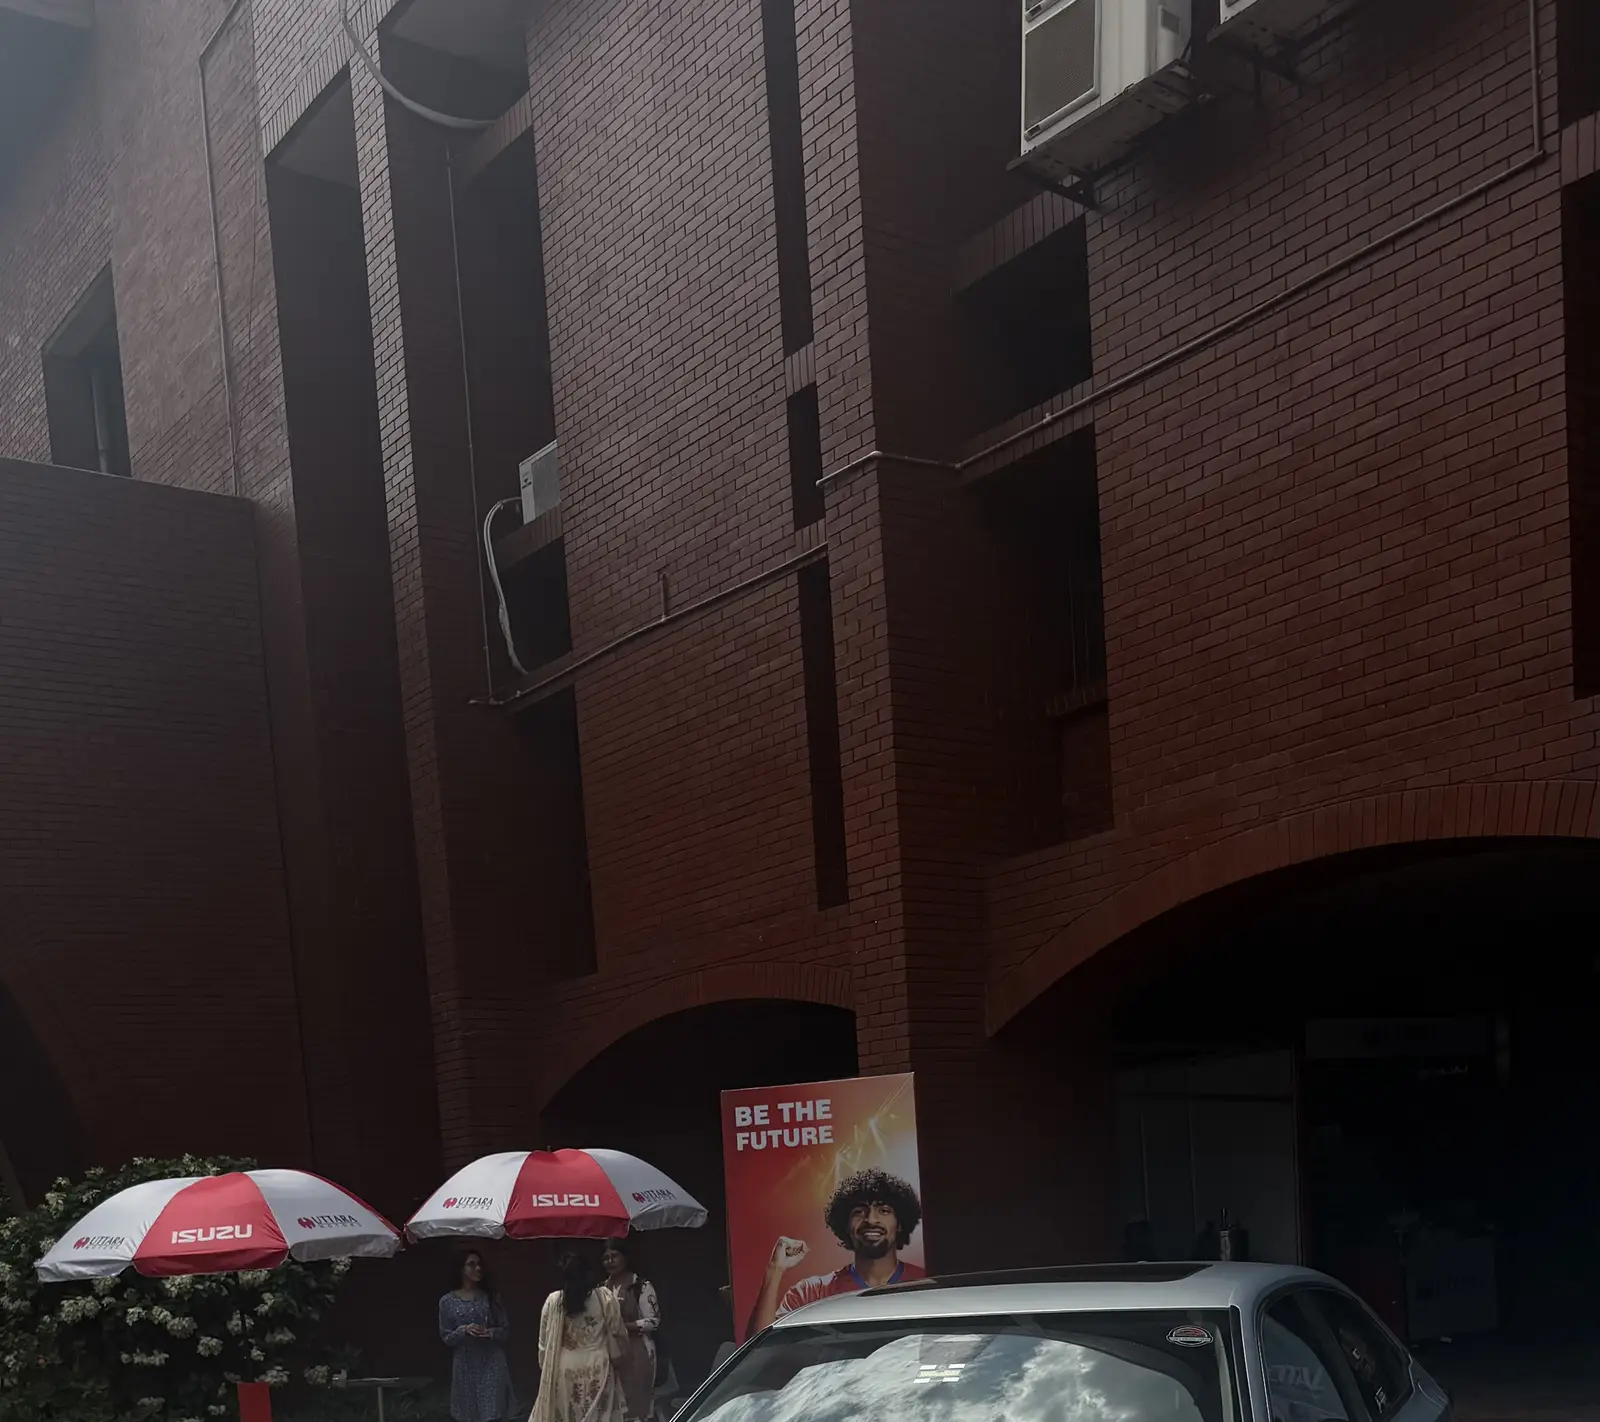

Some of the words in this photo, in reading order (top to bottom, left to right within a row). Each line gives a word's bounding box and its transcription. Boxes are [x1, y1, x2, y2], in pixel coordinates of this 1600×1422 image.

[735, 1105, 770, 1127] BE
[777, 1099, 833, 1123] THE
[736, 1125, 834, 1151] FUTURE
[457, 1197, 494, 1206] UTTARA
[532, 1194, 600, 1207] ISUZU
[311, 1214, 359, 1225] UTTARA
[171, 1224, 253, 1244] ISUZU
[89, 1236, 125, 1246] UTTARA
